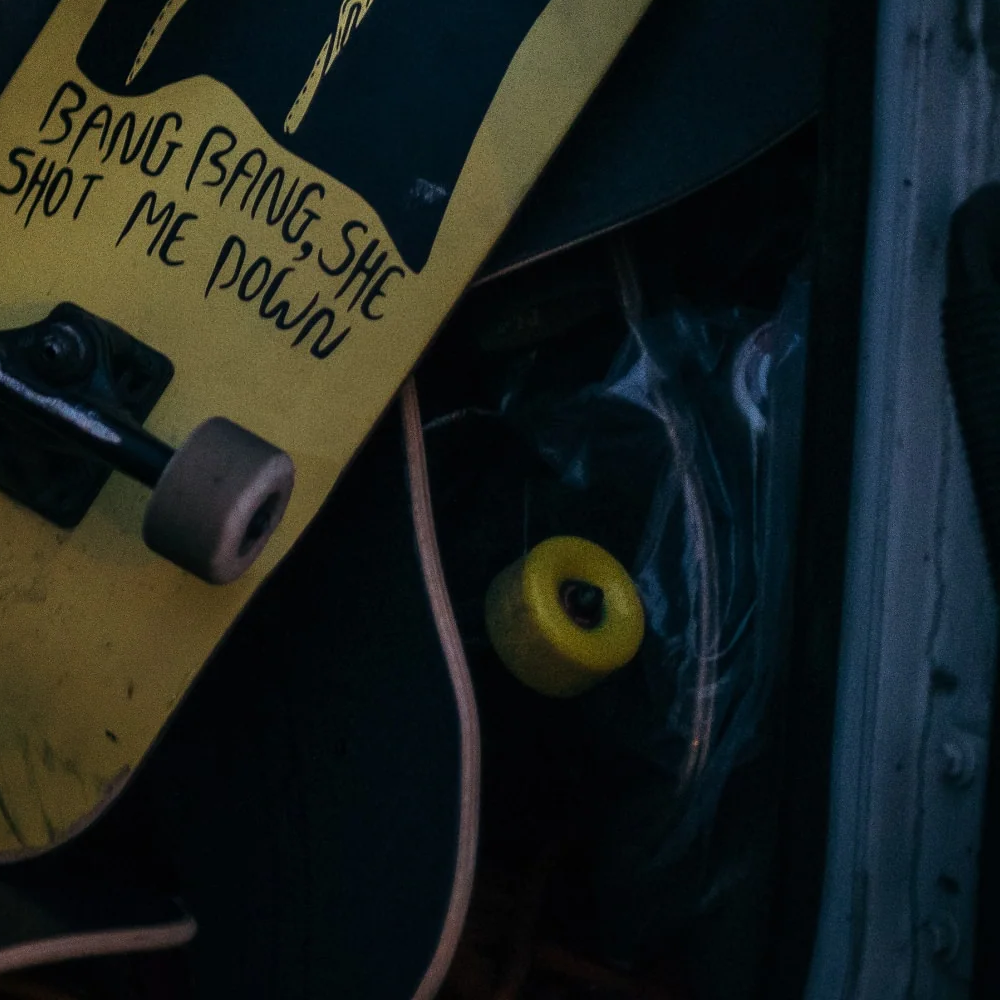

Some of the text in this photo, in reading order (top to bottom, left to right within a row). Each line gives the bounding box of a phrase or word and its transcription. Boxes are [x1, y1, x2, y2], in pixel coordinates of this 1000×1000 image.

[39, 81, 405, 320] BANG BANG, SHE
[116, 191, 198, 266] ME
[204, 235, 351, 359] DOWN
